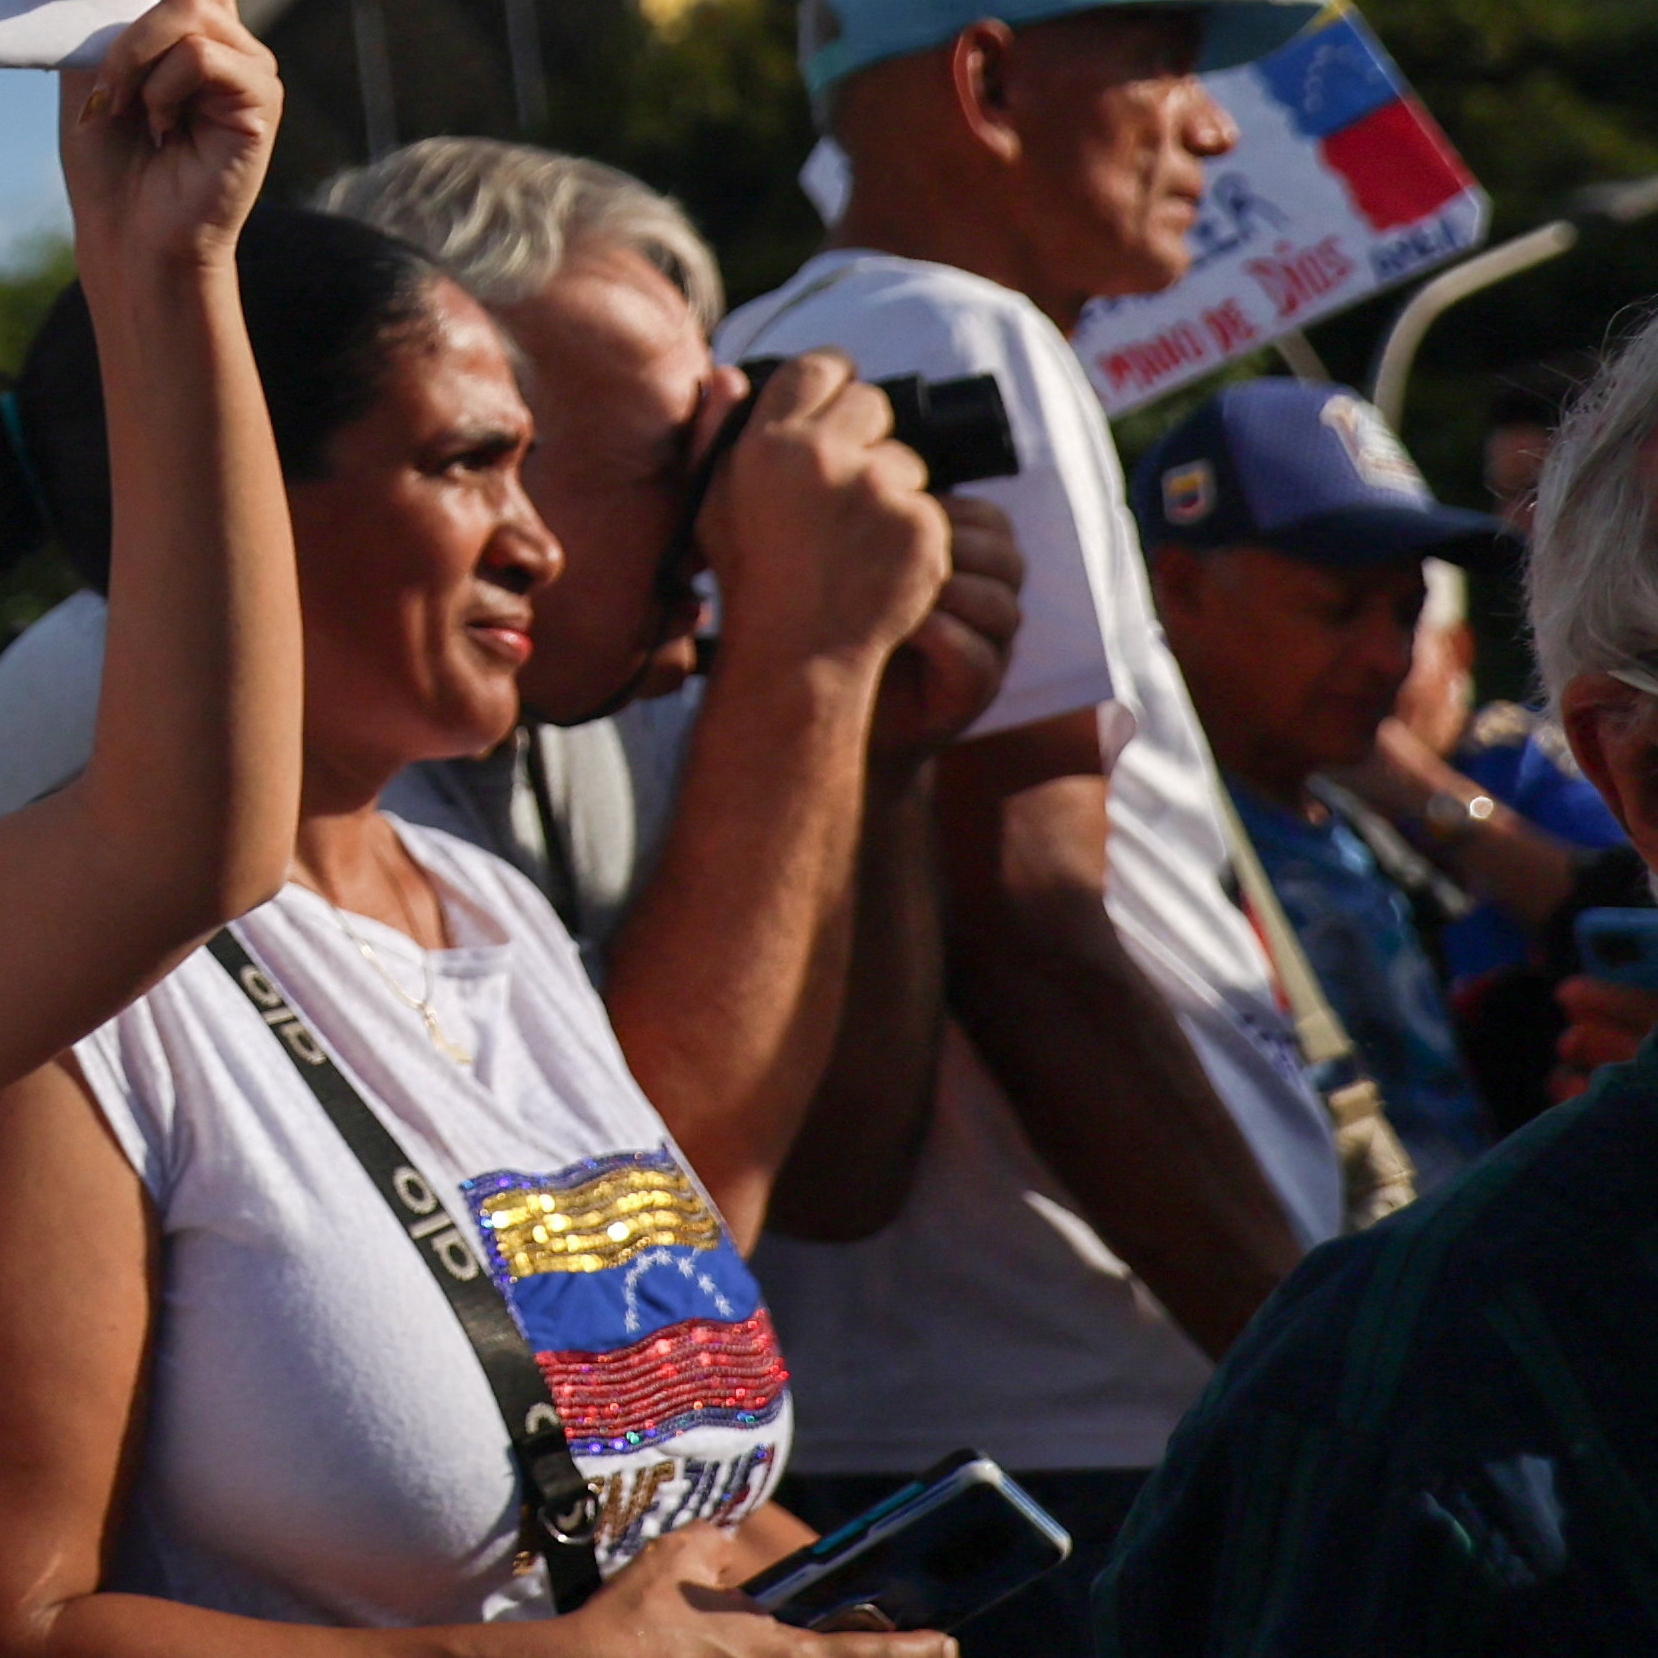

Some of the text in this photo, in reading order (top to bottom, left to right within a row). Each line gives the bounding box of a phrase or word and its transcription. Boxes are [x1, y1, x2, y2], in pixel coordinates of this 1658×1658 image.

[1203, 296, 1258, 354] DE
[240, 964, 479, 1281] alo alo
